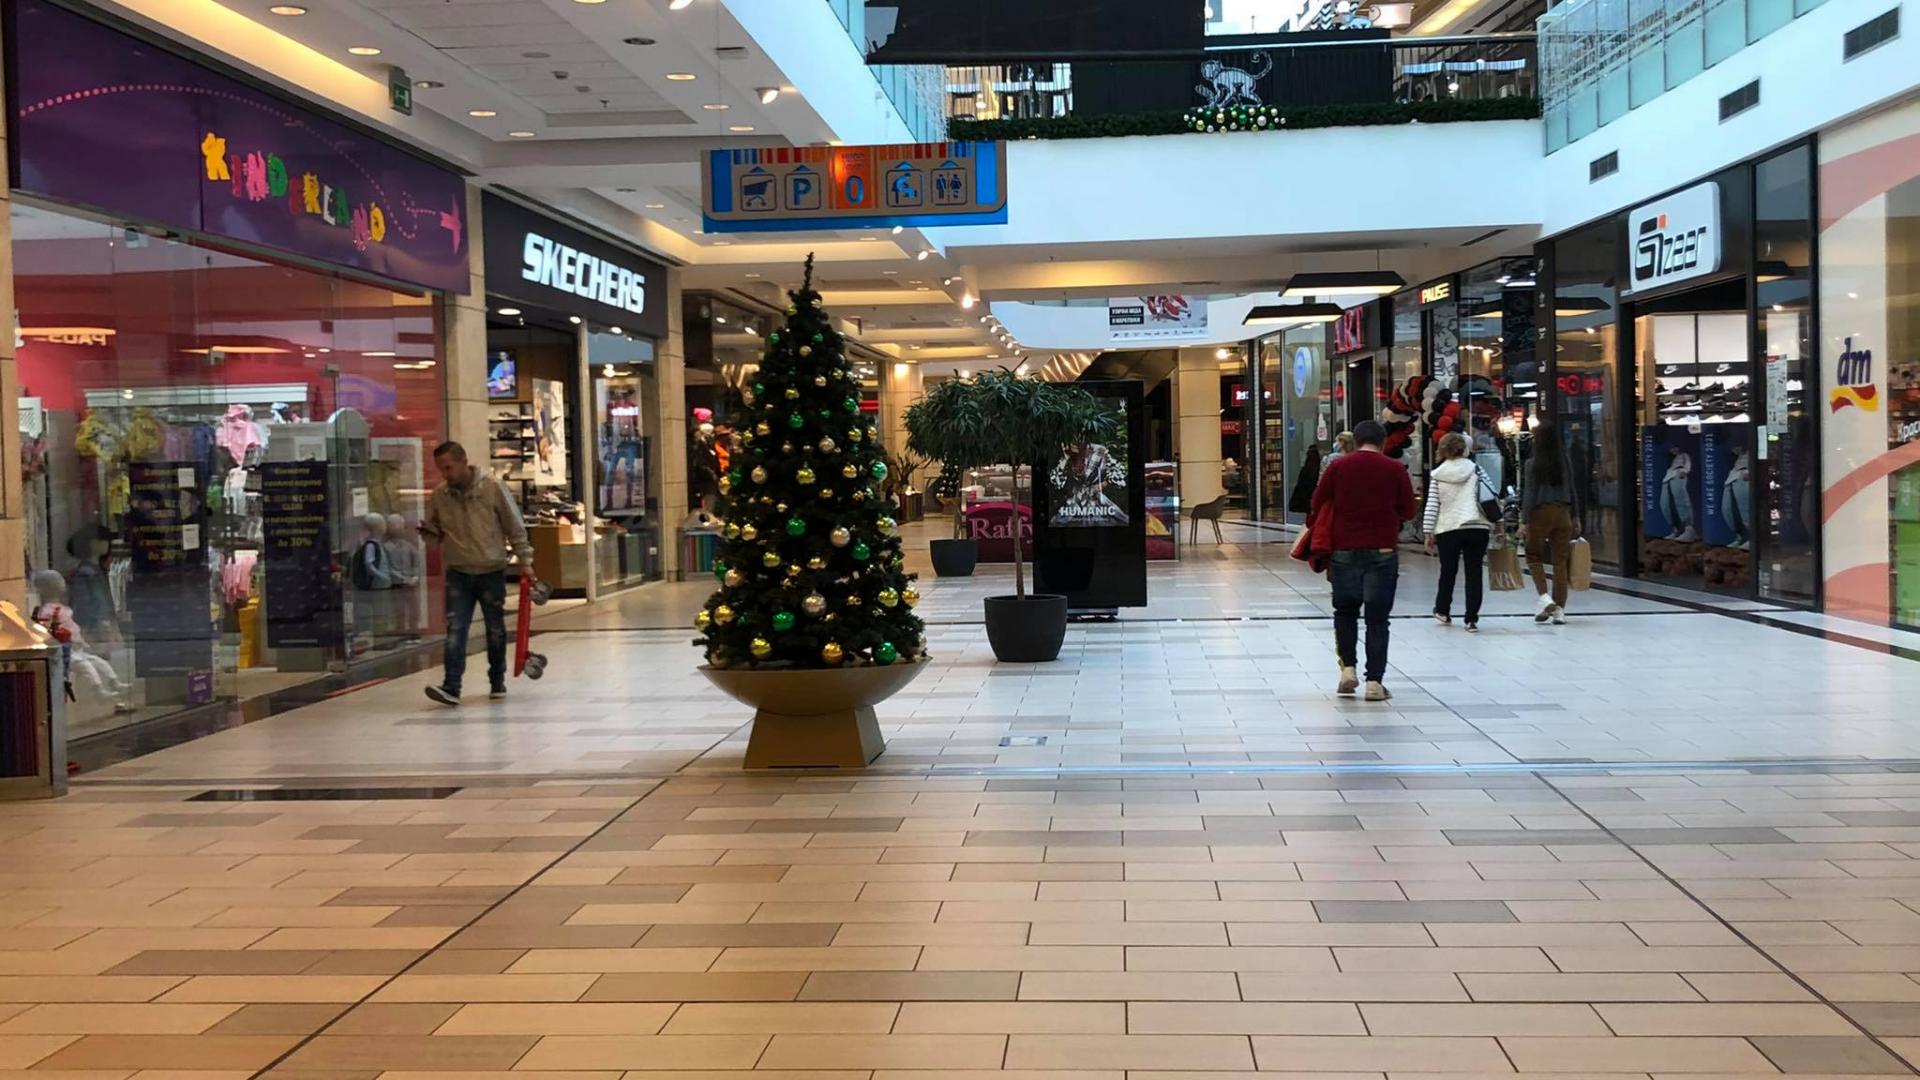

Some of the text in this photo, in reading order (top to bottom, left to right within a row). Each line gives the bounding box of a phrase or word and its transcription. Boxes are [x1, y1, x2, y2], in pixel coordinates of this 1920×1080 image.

[793, 178, 812, 206] P
[522, 232, 645, 314] SKECHERS
[1421, 282, 1450, 304] PAUSE
[1837, 337, 1871, 386] dm
[1060, 506, 1116, 517] HUMANIC
